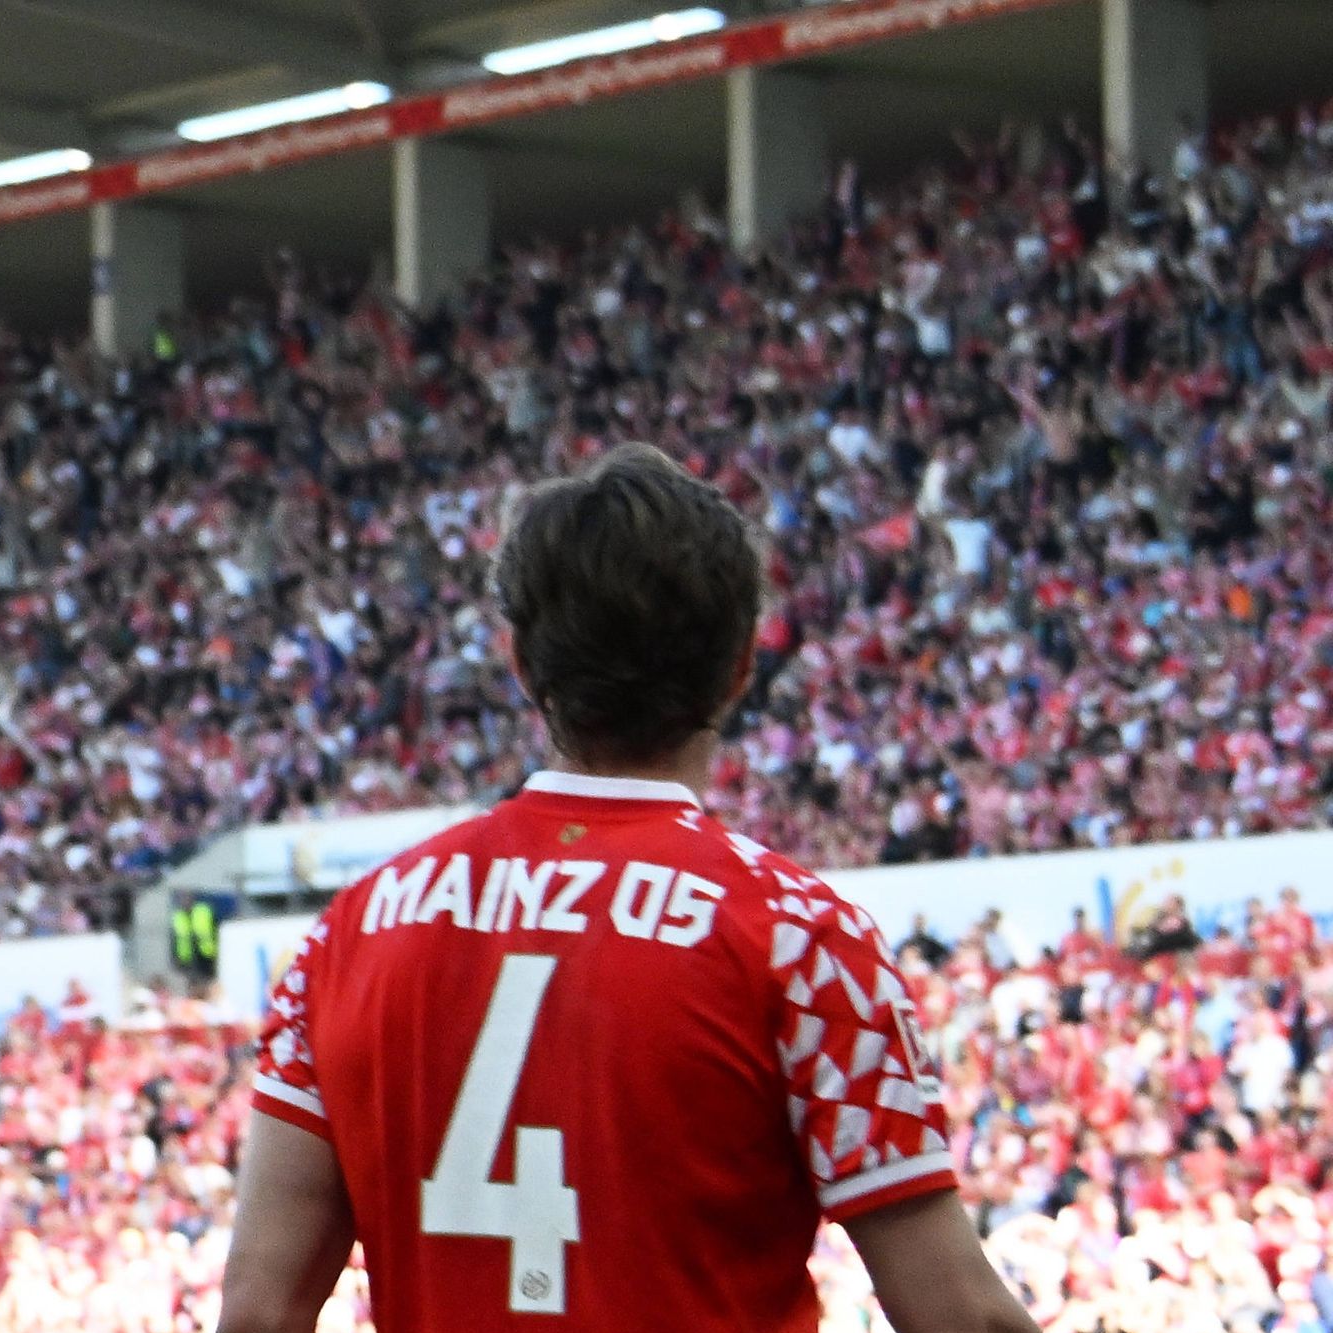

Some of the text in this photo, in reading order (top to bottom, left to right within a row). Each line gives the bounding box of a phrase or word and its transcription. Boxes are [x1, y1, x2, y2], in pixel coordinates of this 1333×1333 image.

[361, 853, 727, 948] MAINZ 05
[420, 954, 580, 1314] 4
